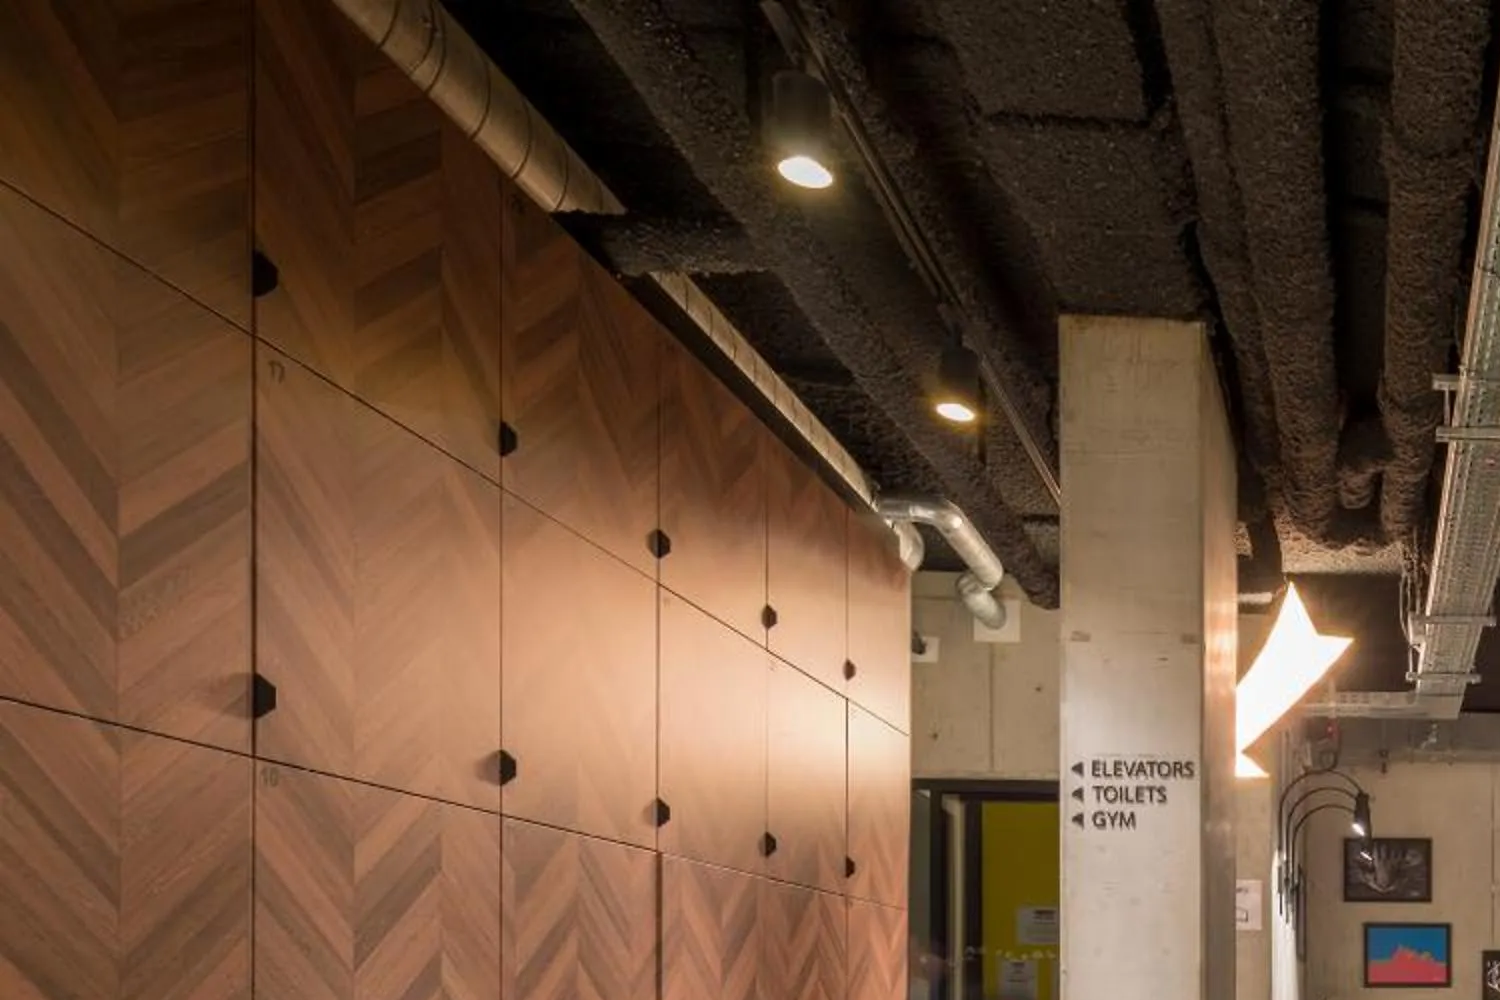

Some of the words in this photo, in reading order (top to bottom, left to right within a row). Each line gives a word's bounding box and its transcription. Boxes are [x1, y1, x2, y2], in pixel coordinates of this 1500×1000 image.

[1091, 760, 1195, 778] ELEVATORS
[1092, 786, 1167, 804] TOILETS
[1092, 811, 1136, 830] GYM
